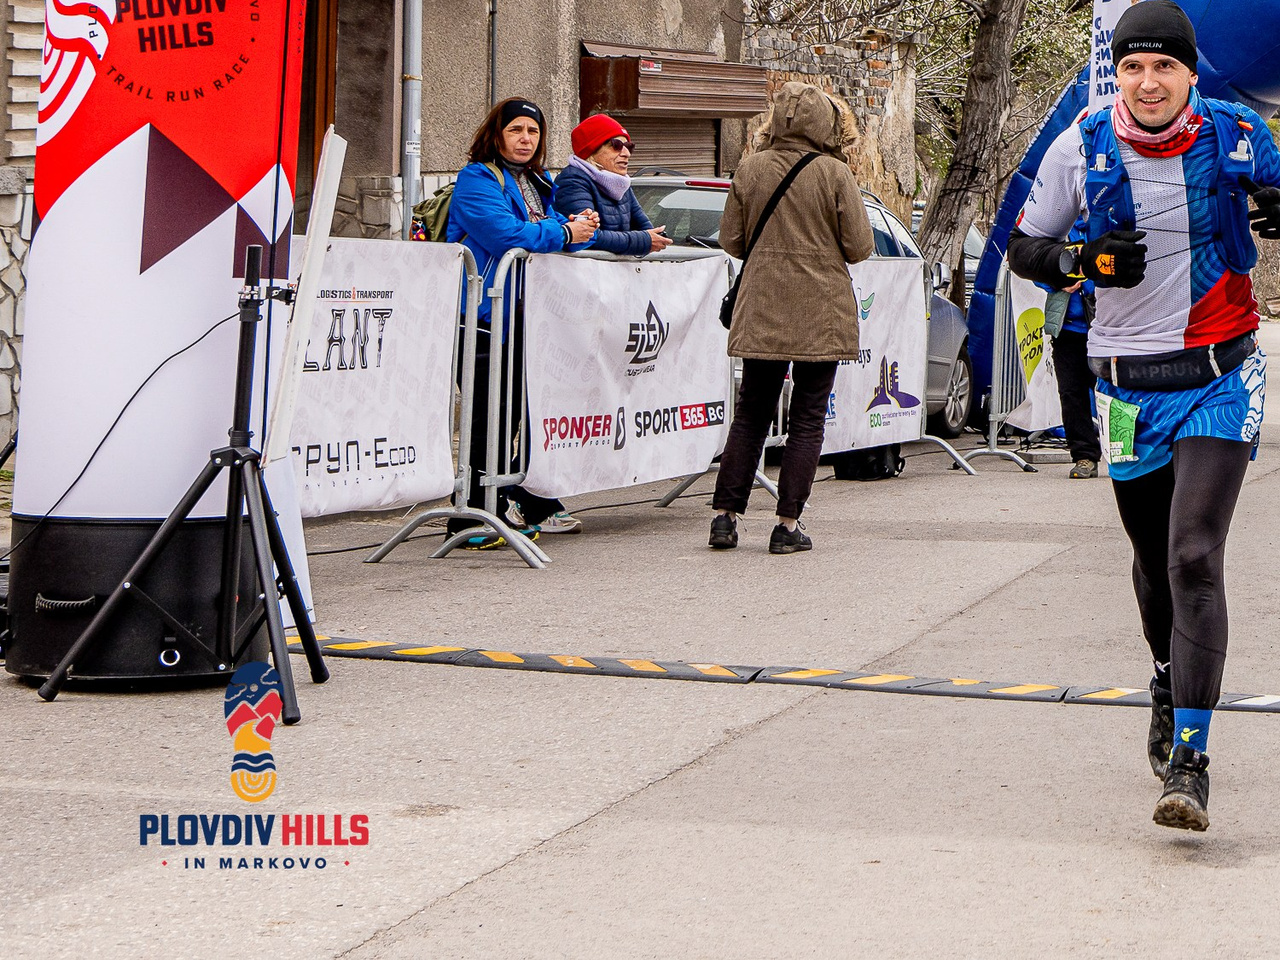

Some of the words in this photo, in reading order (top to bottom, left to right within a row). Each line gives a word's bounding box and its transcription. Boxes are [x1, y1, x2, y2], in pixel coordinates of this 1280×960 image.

[138, 21, 214, 53] HILLS
[106, 65, 154, 100] TRAIL
[166, 87, 205, 102] RUN
[212, 53, 250, 90] RACE
[356, 290, 394, 299] TRANSPORT
[543, 414, 612, 451] SPONSER
[869, 413, 882, 428] ECO
